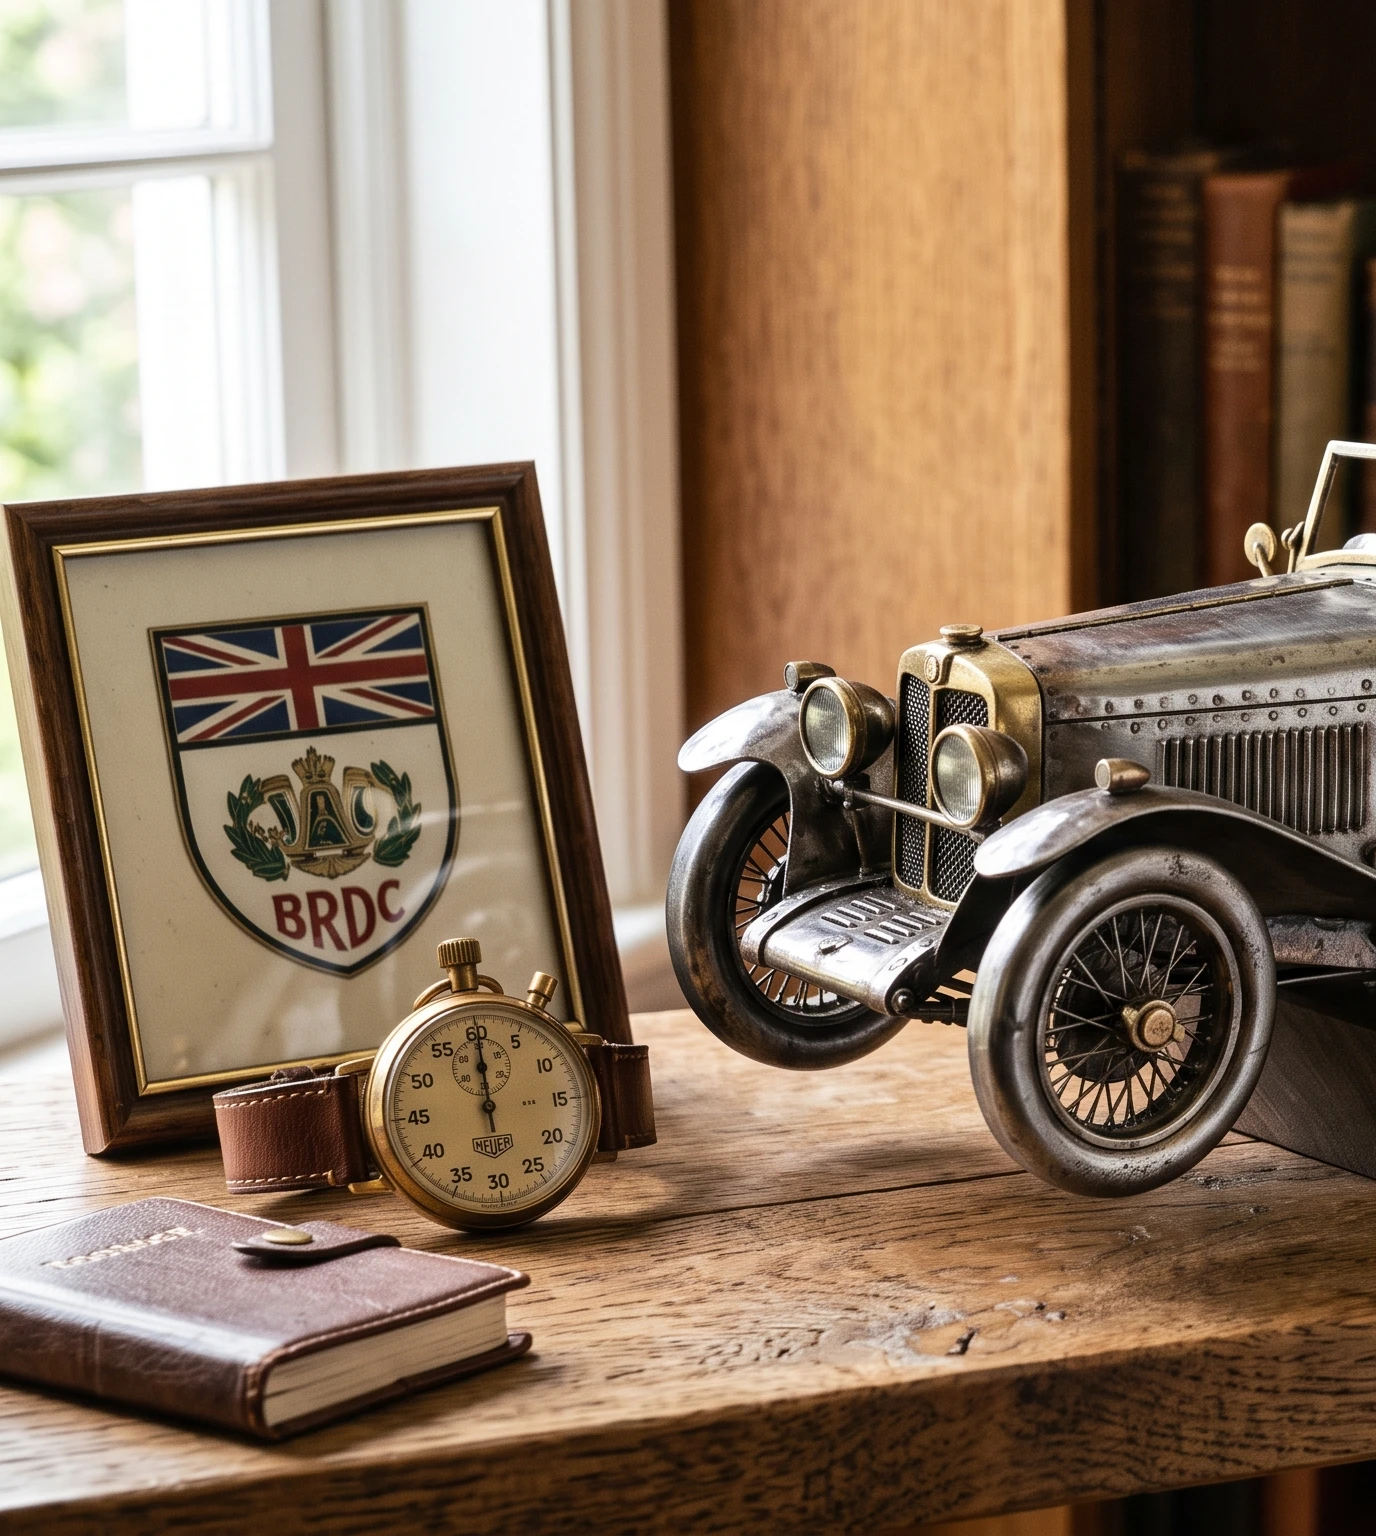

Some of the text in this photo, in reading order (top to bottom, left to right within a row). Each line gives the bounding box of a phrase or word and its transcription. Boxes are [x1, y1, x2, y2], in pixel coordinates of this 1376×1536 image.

[272, 879, 405, 952] BRDC
[466, 1025, 487, 1041] 60
[511, 1034, 521, 1049] 5
[431, 1042, 454, 1058] 55
[537, 1057, 553, 1073] 10
[411, 1073, 434, 1089] 50
[552, 1091, 568, 1107] 15
[408, 1109, 430, 1125] 45
[541, 1128, 563, 1145] 20
[422, 1143, 445, 1160] 40
[522, 1157, 545, 1174] 25
[450, 1166, 473, 1184] 35
[487, 1173, 510, 1190] 30
